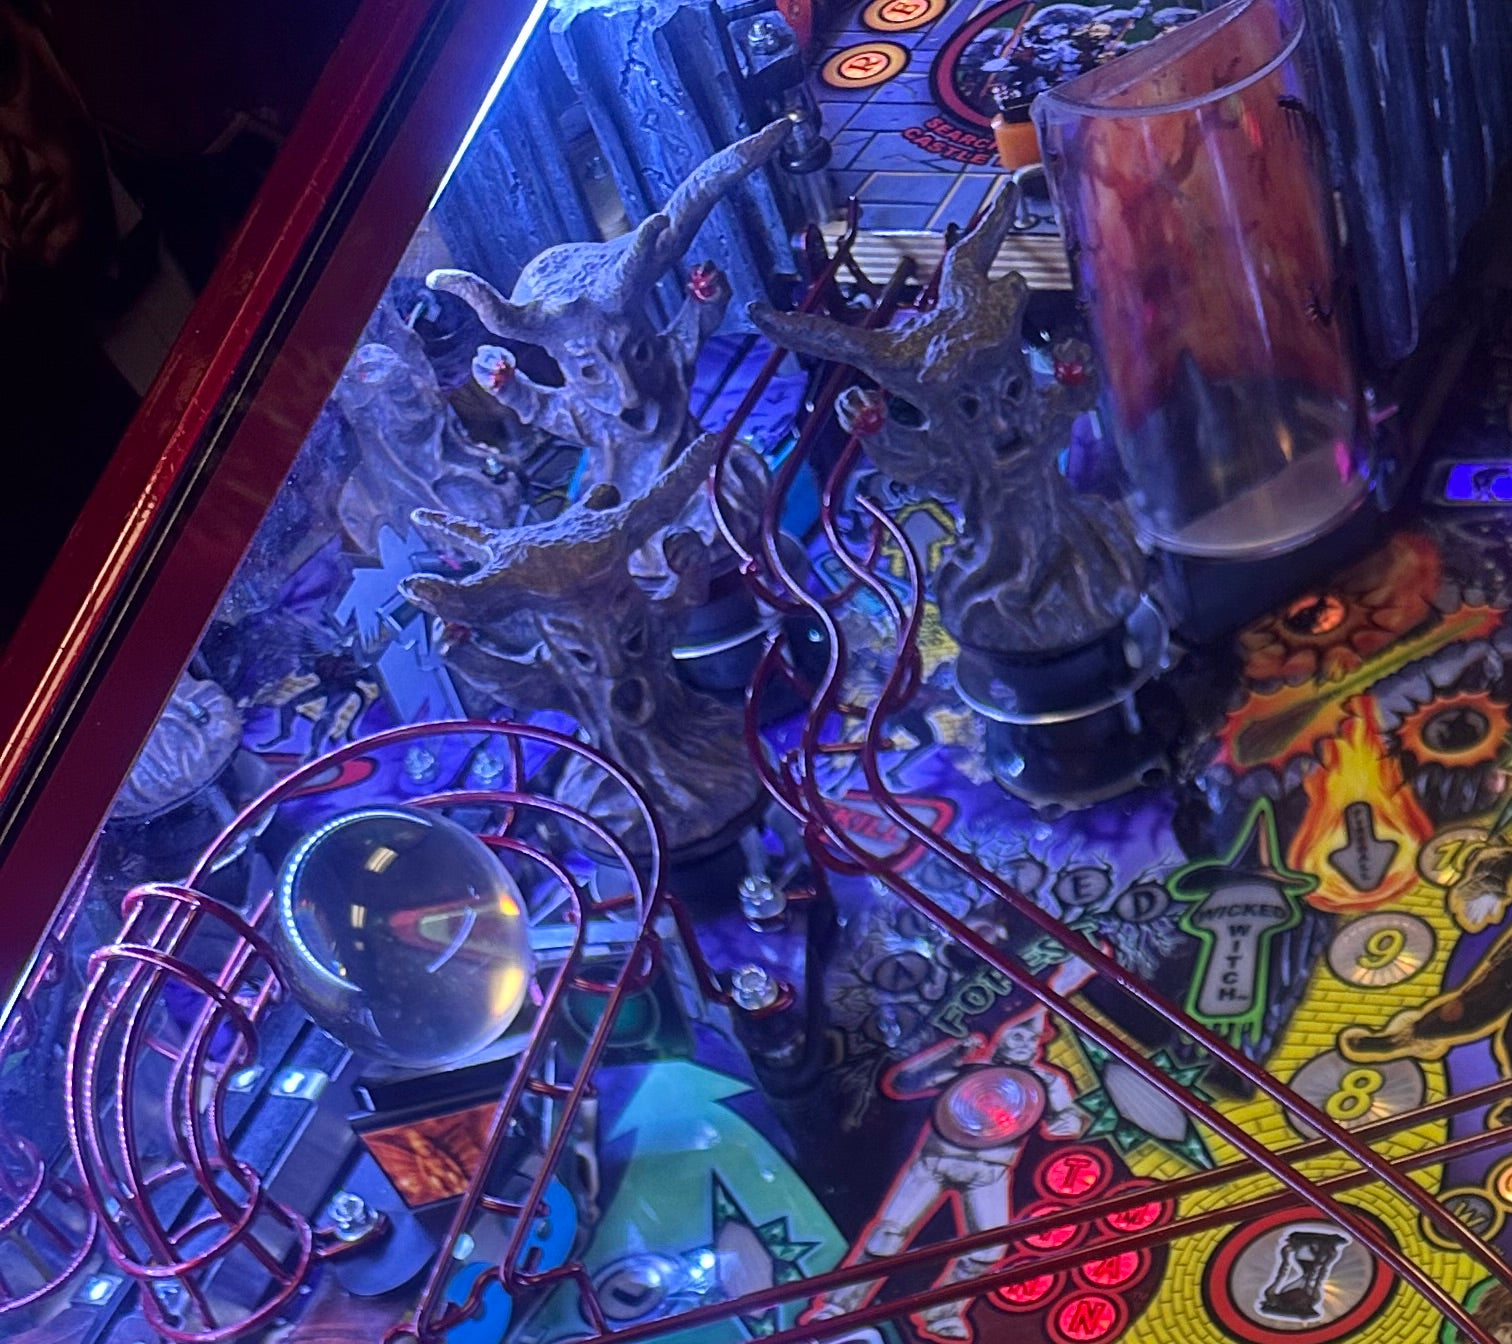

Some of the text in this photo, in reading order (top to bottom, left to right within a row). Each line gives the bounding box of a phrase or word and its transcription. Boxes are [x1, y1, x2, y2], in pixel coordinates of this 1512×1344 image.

[903, 127, 988, 165] CASTLE
[1357, 928, 1408, 970] 9
[1326, 1068, 1387, 1120] 8
